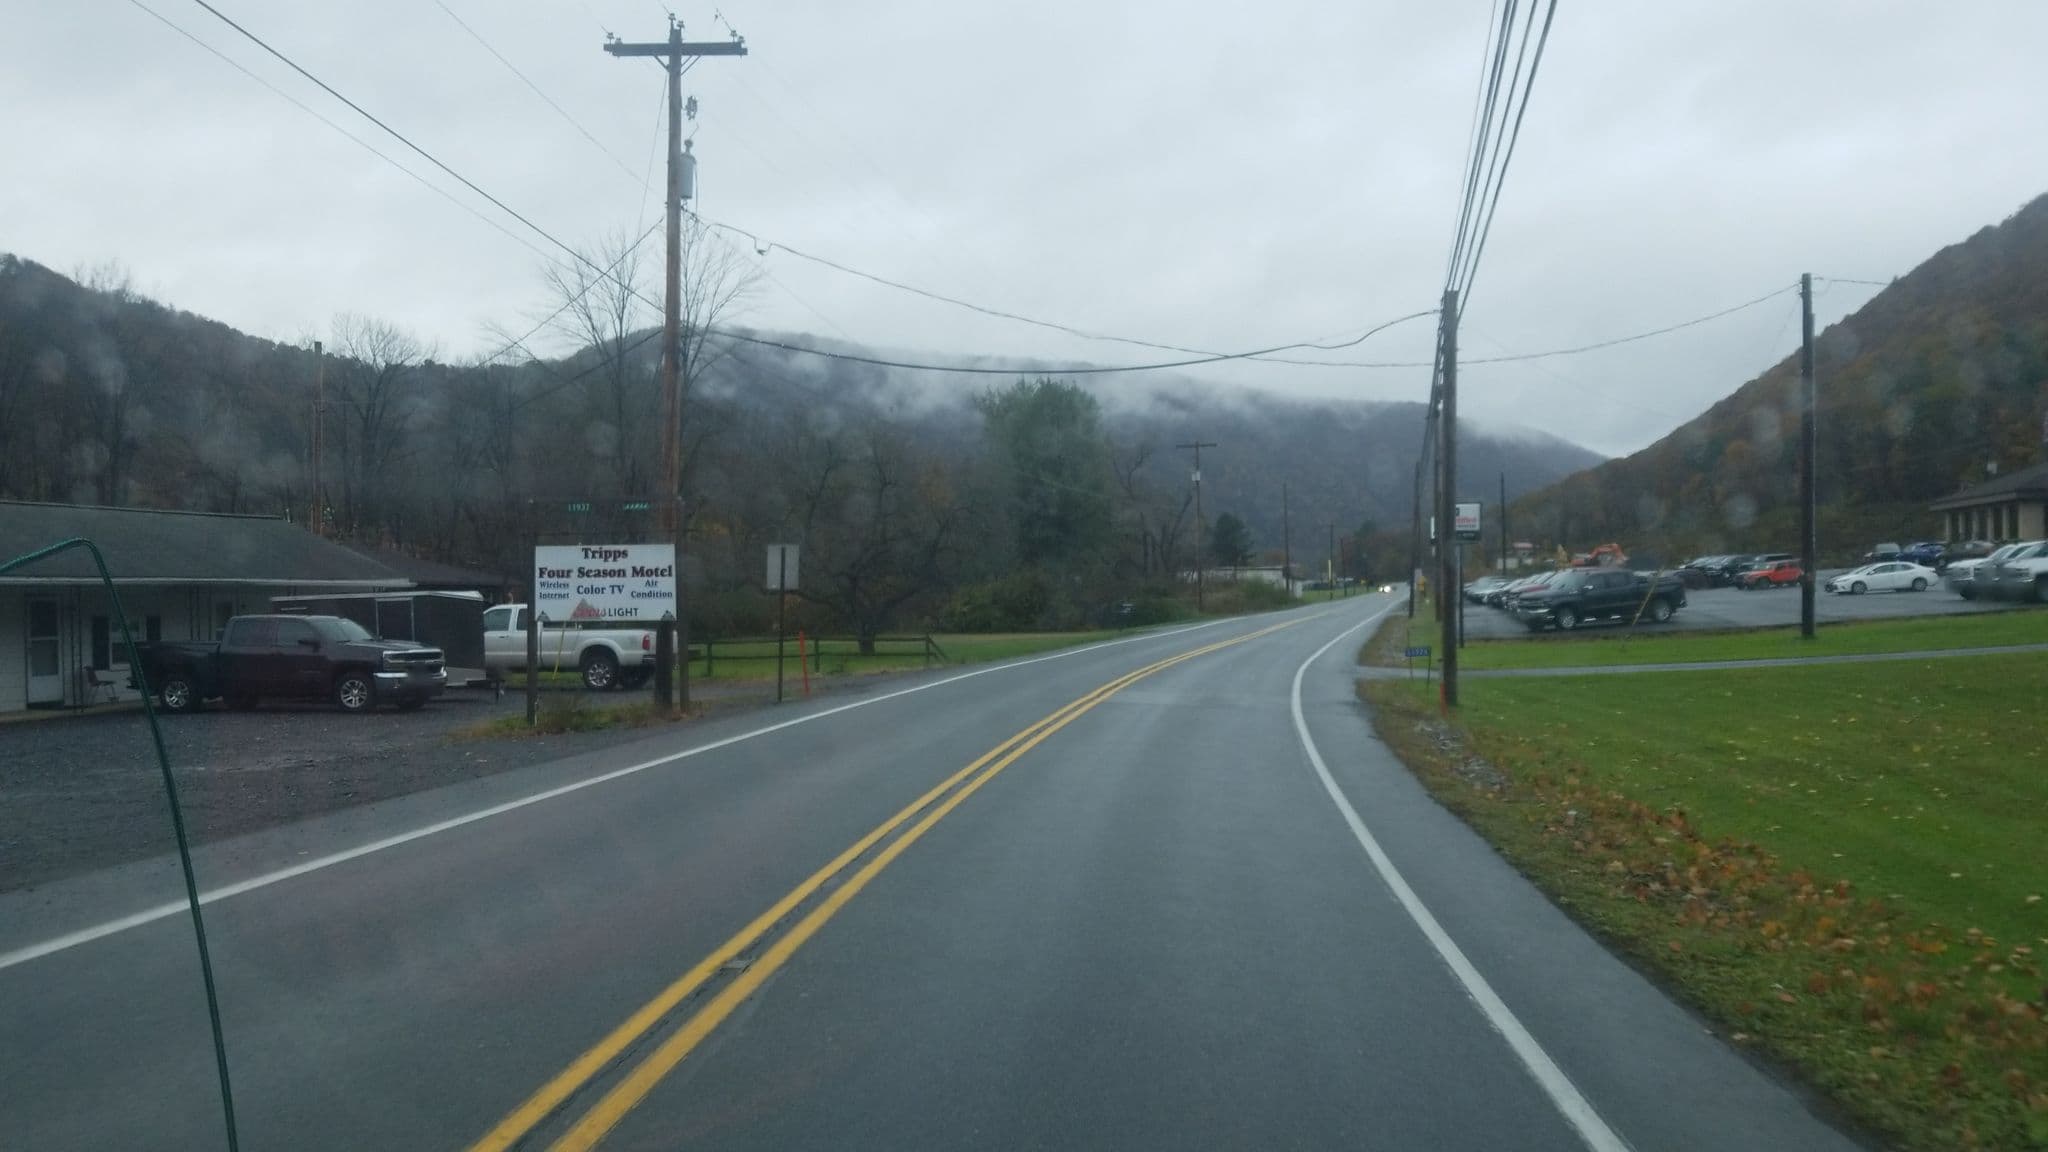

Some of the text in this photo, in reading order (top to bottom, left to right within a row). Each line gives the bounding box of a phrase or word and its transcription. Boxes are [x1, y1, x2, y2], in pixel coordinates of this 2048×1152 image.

[582, 547, 628, 562] Tripps
[538, 565, 673, 579] Four Season Motel
[539, 581, 570, 589] Wireless
[644, 579, 658, 587] Air
[576, 584, 625, 595] Color TV
[539, 592, 570, 600] Internet
[630, 590, 673, 599] Condition
[608, 607, 640, 617] LIGHT
